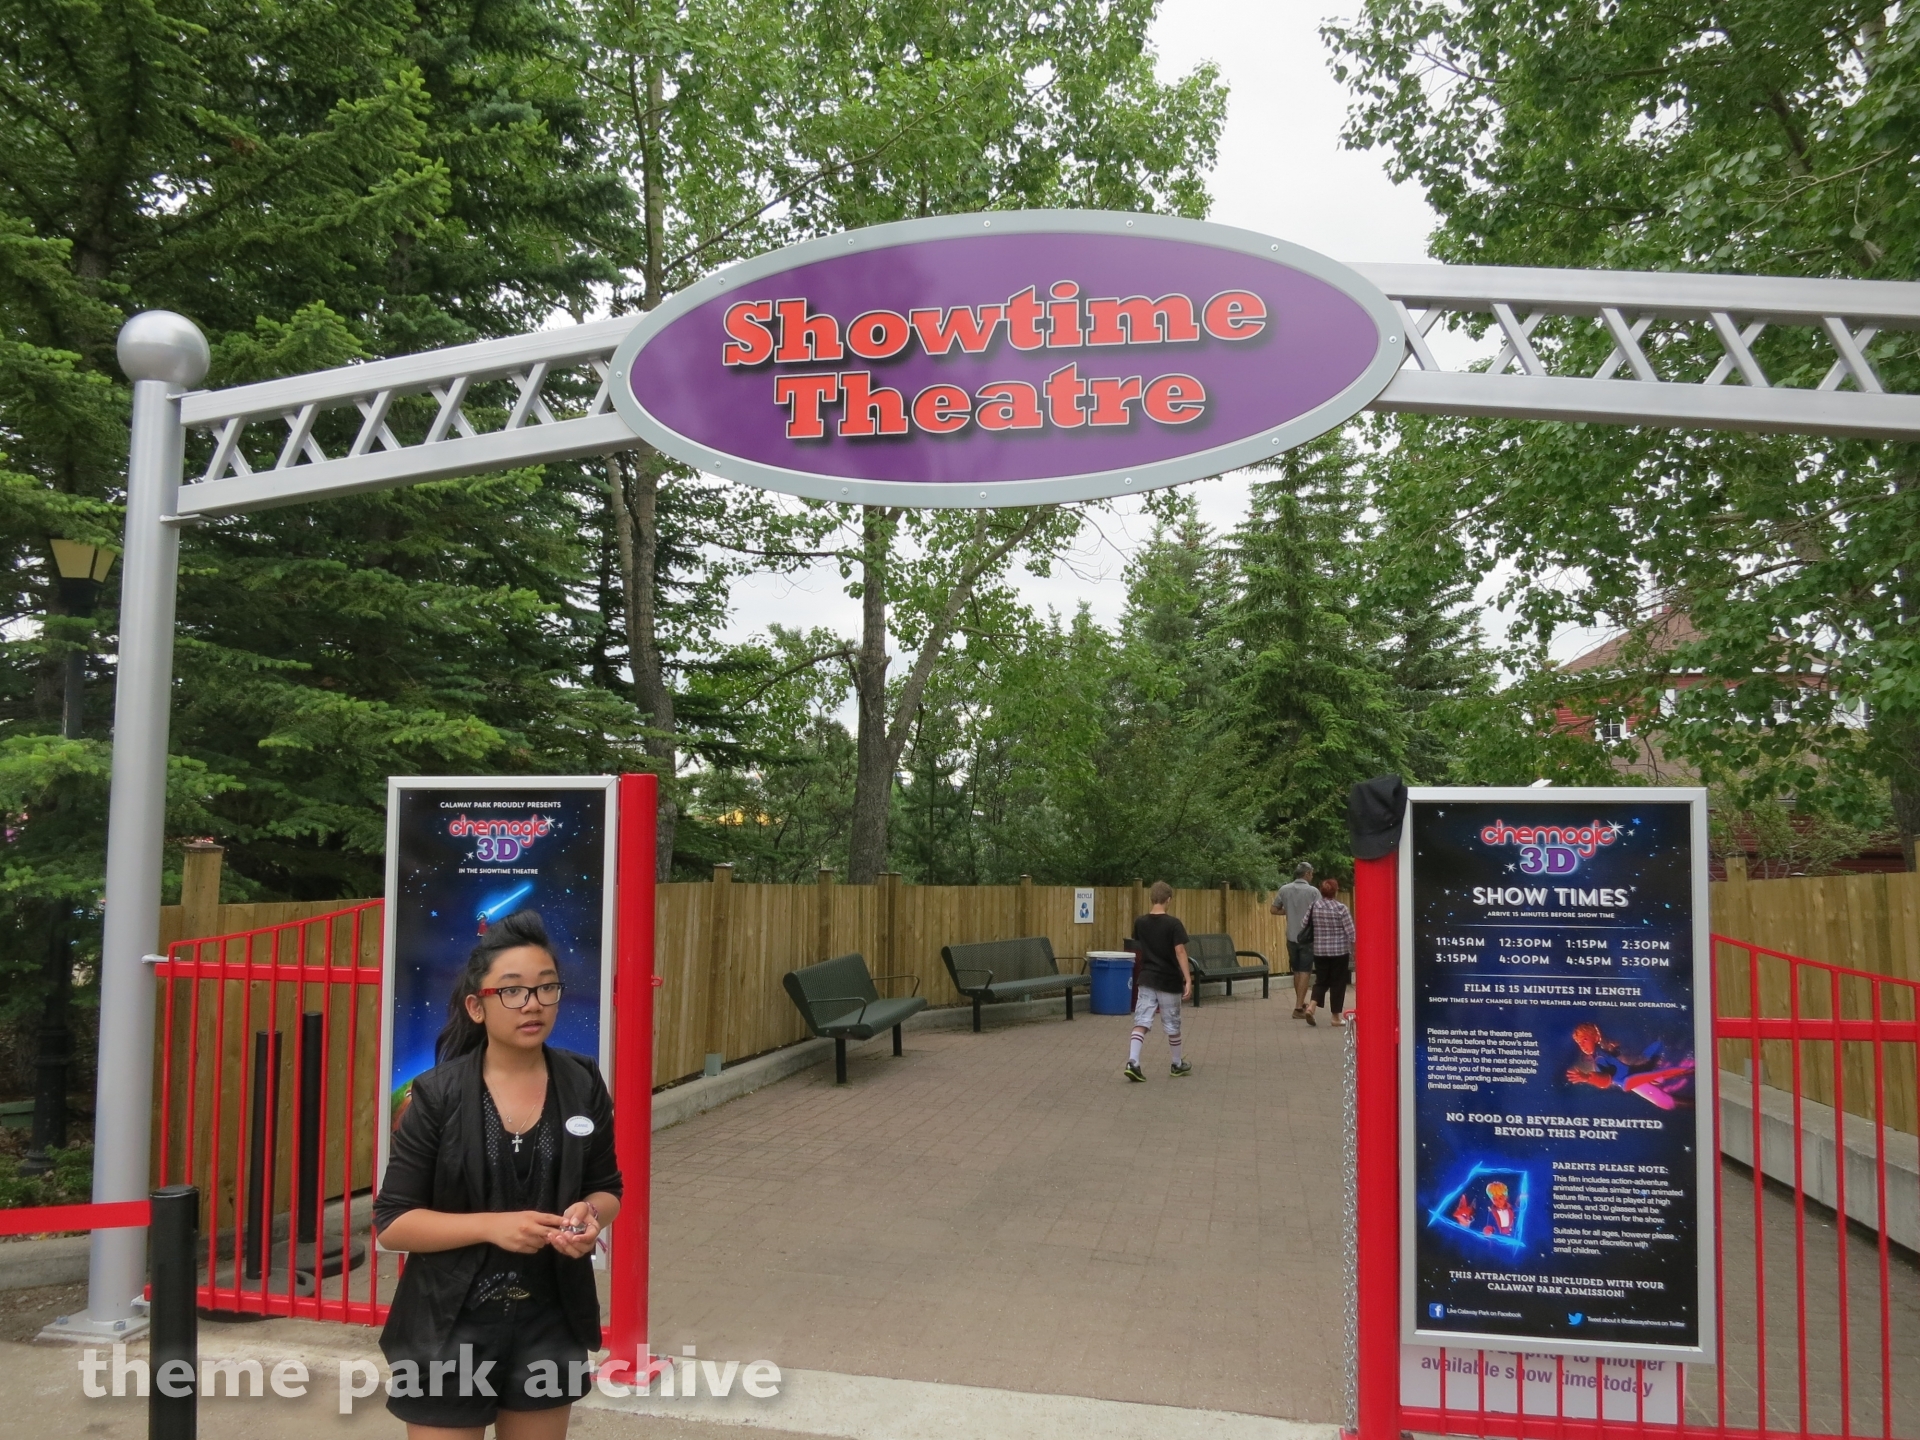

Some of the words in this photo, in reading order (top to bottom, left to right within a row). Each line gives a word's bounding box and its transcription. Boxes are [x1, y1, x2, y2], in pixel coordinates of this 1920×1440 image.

[723, 280, 1267, 366] Showtime
[775, 362, 1206, 439] Theatre
[449, 814, 549, 848] cinemagic
[1481, 819, 1616, 858] cinemagic
[477, 837, 520, 861] 3D
[1520, 847, 1577, 874] 3D
[1472, 886, 1548, 906] SHOW
[1554, 888, 1629, 907] TIMES
[1435, 937, 1486, 947] 11:45AM
[1499, 938, 1552, 948] 12:30PM
[1565, 939, 1607, 949] 1:15PM
[1621, 940, 1670, 950] 2:30PM
[1435, 953, 1477, 963] 3:15PM
[1499, 955, 1549, 965] 4:00PM
[1566, 956, 1612, 966] 4:45PM
[1621, 957, 1669, 967] 5:30PM
[1464, 984, 1490, 992] FILM
[1508, 985, 1520, 993] 15
[1523, 986, 1574, 994] MINUTES
[1451, 1047, 1480, 1055] Calaway
[1446, 1113, 1464, 1122] NO
[1468, 1114, 1502, 1123] FOOD
[1505, 1115, 1523, 1124] OR
[1526, 1116, 1589, 1126] BEVERAGE
[1592, 1119, 1662, 1129] PERMITTED
[1494, 1127, 1544, 1137] BEYOND
[1547, 1129, 1576, 1138] THIS
[1579, 1130, 1618, 1140] POINT
[1552, 1162, 1596, 1171] PARENTS
[1598, 1164, 1634, 1172] PLEASE
[1610, 1178, 1668, 1186] action-adventure
[1449, 1271, 1472, 1279] THIS
[1474, 1273, 1536, 1282] ATTRACTION
[1551, 1277, 1604, 1286] INCLUDED
[1606, 1280, 1633, 1288] WITH
[1635, 1281, 1664, 1289] YOUR
[1487, 1283, 1533, 1292] CALAWAY
[1536, 1286, 1562, 1294] PARK
[1564, 1288, 1624, 1297] ADMISSION!
[1561, 1370, 1597, 1388] ime
